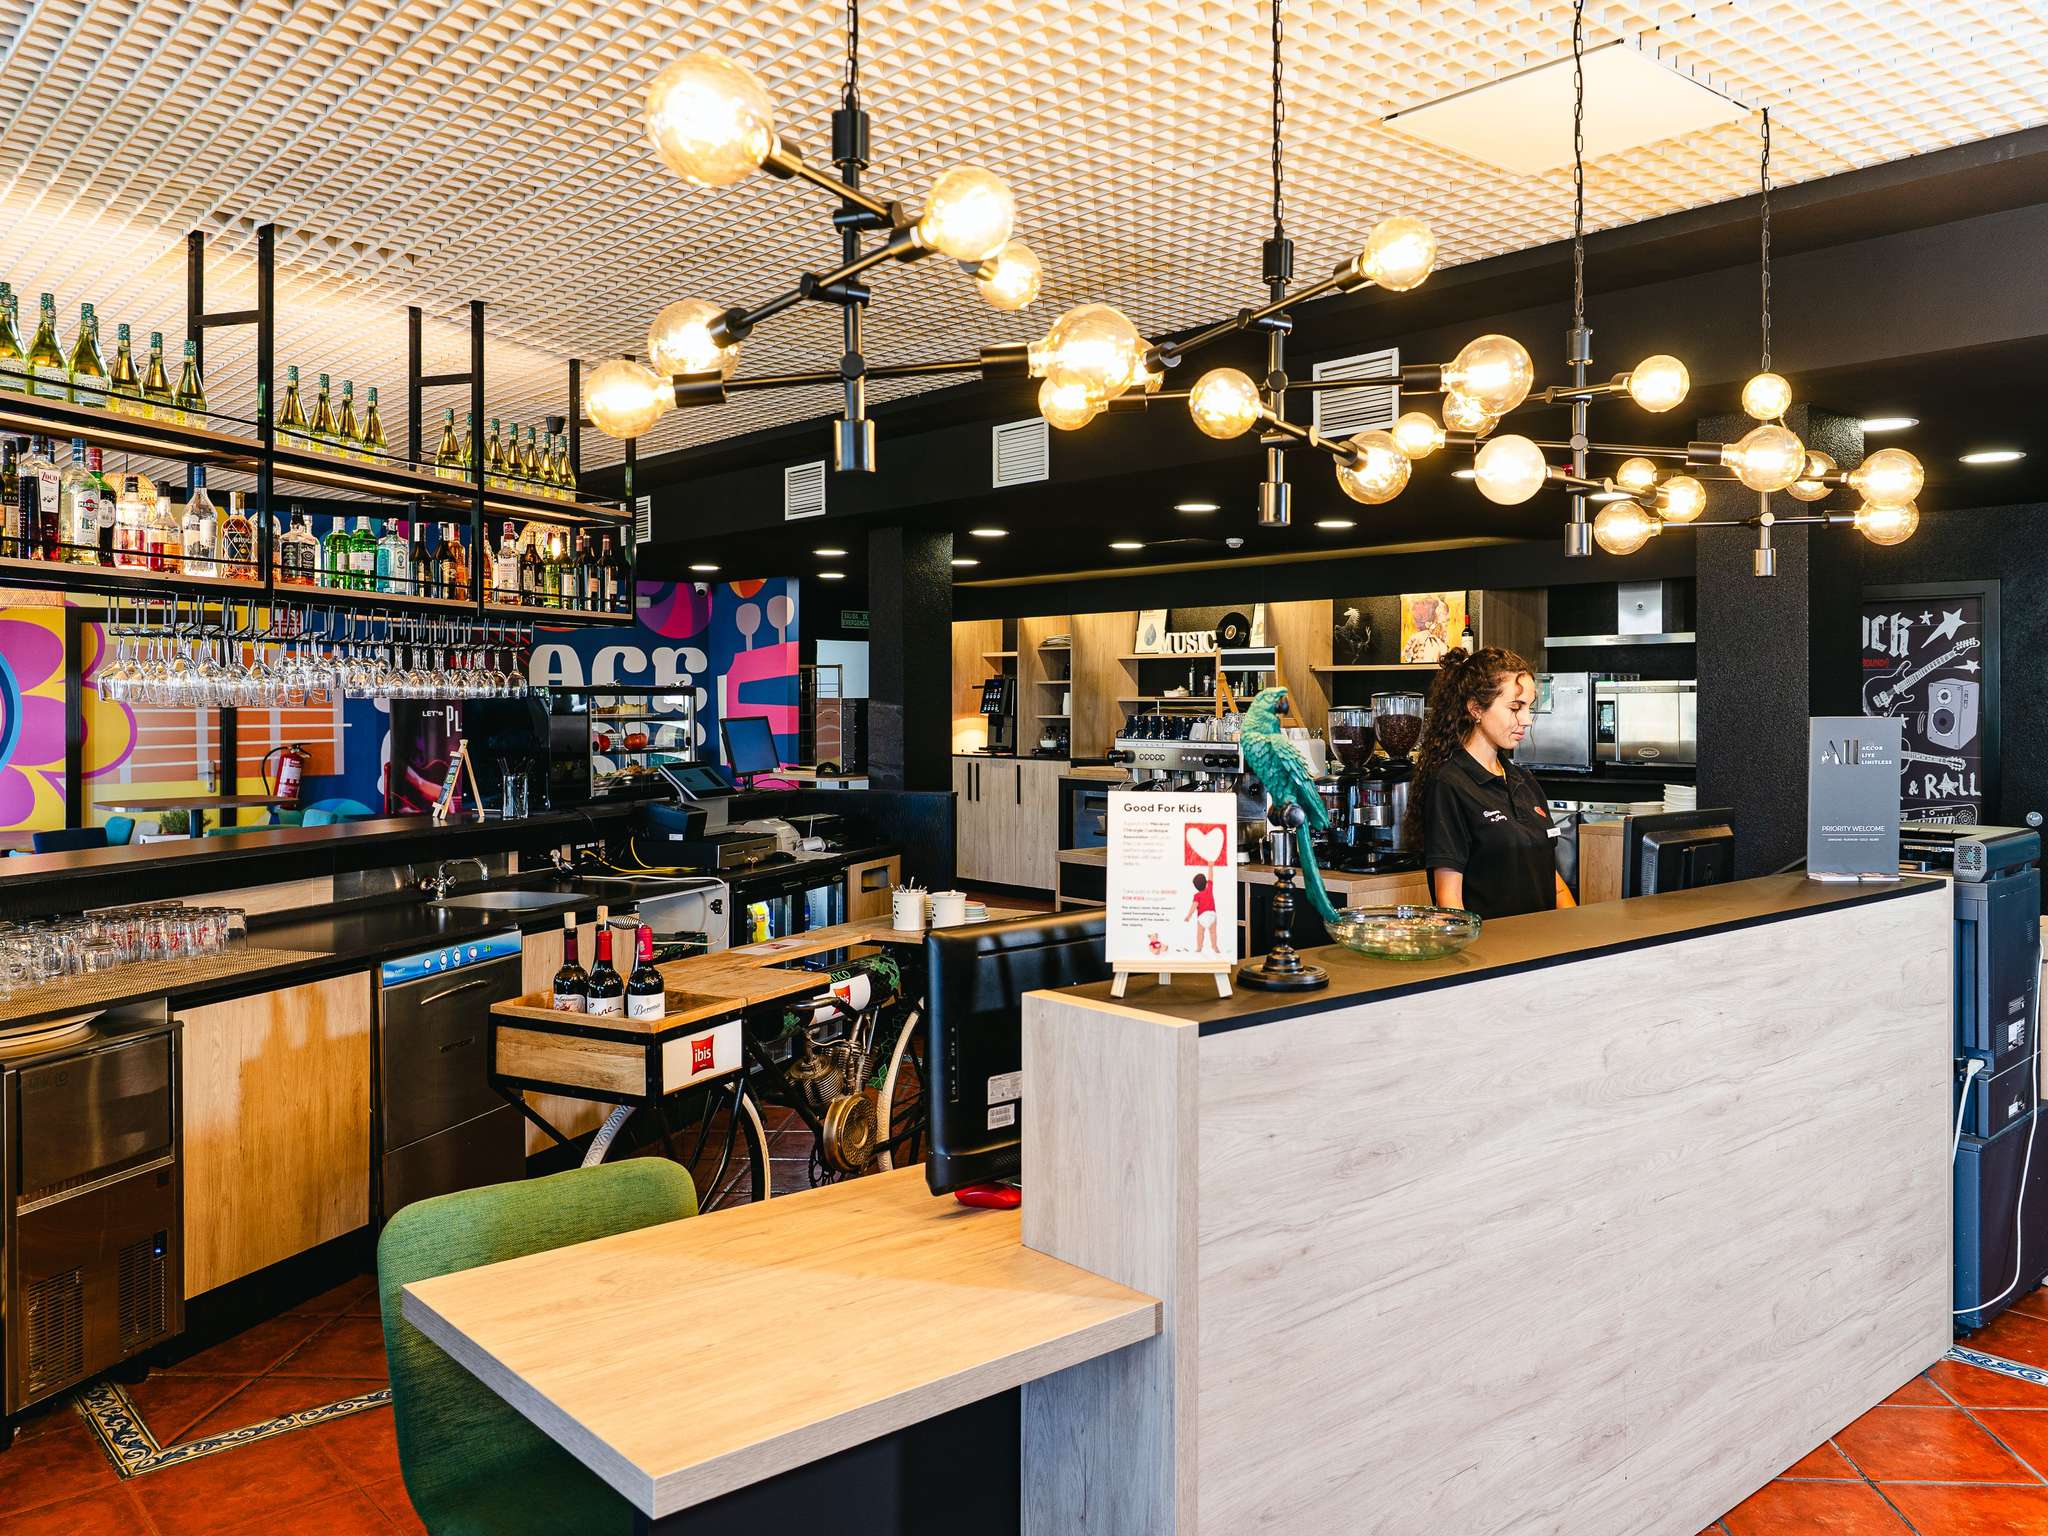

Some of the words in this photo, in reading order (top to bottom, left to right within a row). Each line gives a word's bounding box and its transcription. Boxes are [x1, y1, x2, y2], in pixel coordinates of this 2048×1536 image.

[1158, 630, 1218, 654] MUSIC
[1908, 780, 1919, 796] &
[1123, 803, 1154, 813] Good
[1158, 804, 1175, 813] For
[1178, 804, 1203, 813] Kids
[694, 1046, 712, 1062] ibis
